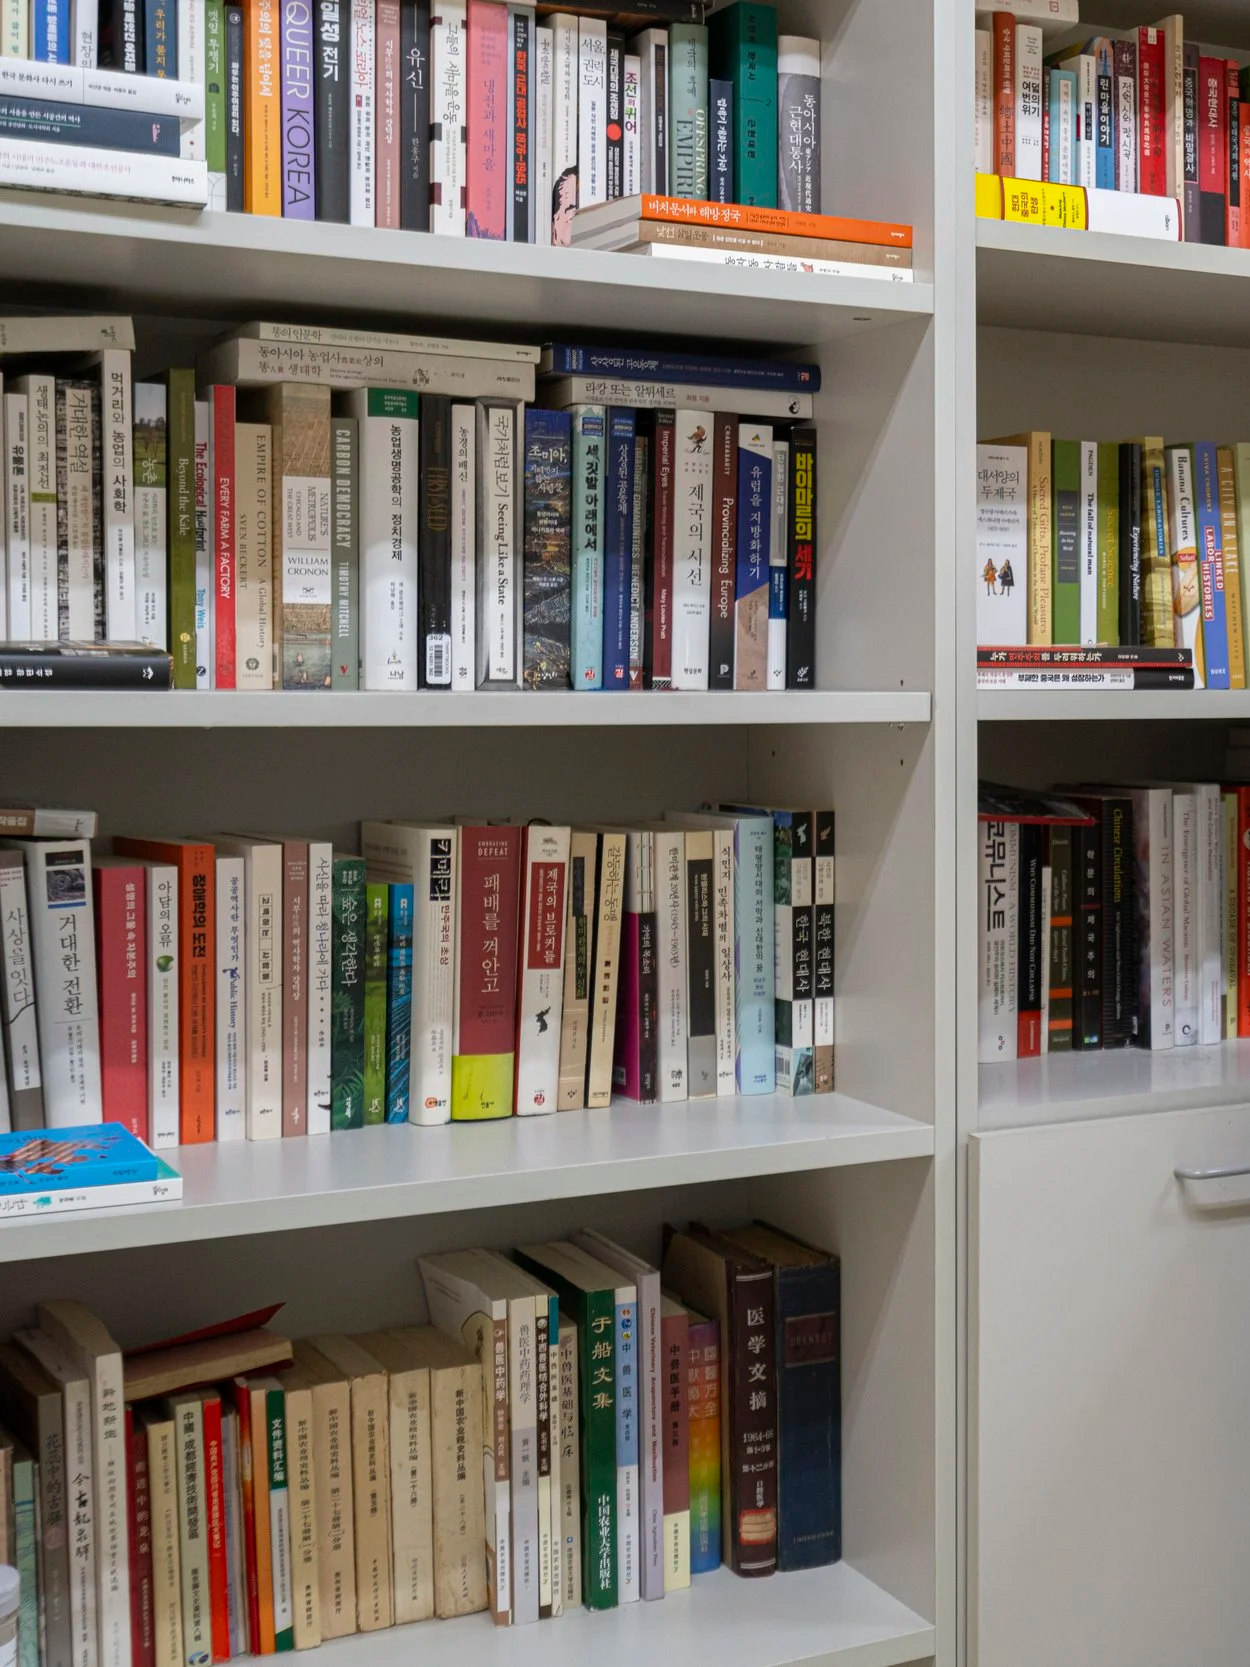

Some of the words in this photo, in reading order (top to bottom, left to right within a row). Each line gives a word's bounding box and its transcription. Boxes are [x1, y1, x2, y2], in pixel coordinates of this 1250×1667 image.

[208, 10, 218, 34] 깻잎
[447, 24, 459, 57] 그들의
[208, 39, 219, 74] 투쟁기
[286, 0, 309, 99] QUEER
[582, 38, 606, 56] 서울,
[583, 59, 604, 74] 권력
[406, 48, 426, 89] 유신
[583, 75, 604, 90] 도시
[1100, 78, 1109, 88] 린
[443, 61, 461, 124] 새마을운동
[483, 79, 496, 122] 냉전과
[625, 72, 637, 106] 조선의
[1100, 90, 1110, 114] 마을
[625, 107, 637, 134] 퀴어
[789, 106, 803, 174] 근현대통사
[803, 94, 816, 149] 동아시아
[1100, 115, 1110, 146] 이야기
[287, 108, 310, 205] KOREA
[483, 129, 496, 171] 새마을
[111, 372, 124, 424] 먹거리와
[585, 382, 608, 395] 라캉
[610, 384, 632, 397] 또는
[635, 387, 676, 400] 알튀세르
[113, 430, 125, 469] 농업의
[257, 435, 265, 483] EMPIRE
[336, 429, 350, 475] CARBON
[494, 415, 510, 468] 국가처럼
[618, 444, 628, 477] 상상된
[661, 431, 670, 465] Imperial
[391, 424, 402, 508] 농업생명공학의
[495, 469, 510, 499] 보기
[586, 462, 598, 486] 깃발
[661, 467, 670, 488] Eyes
[978, 470, 1019, 485] 대서양의
[1177, 456, 1188, 493] Banana
[113, 475, 126, 514] 사회학
[220, 477, 230, 503] EVERY
[256, 489, 265, 503] OF
[618, 482, 628, 515] 공동체
[751, 466, 762, 507] 유럽을
[981, 487, 993, 499] 두
[994, 486, 1016, 500] 제국
[1039, 476, 1048, 508] Sacred
[220, 505, 230, 538] FARM
[336, 480, 351, 549] DEMOCRACY
[494, 503, 508, 541] Seeing
[585, 493, 598, 551] 아래에서
[688, 483, 704, 541] 제국의
[1040, 509, 1048, 540] Gifts,
[1178, 496, 1191, 542] Cultures
[221, 541, 230, 550] A
[256, 511, 266, 568] COTTON
[391, 514, 402, 562] 정치경제
[497, 543, 508, 566] Like
[719, 498, 734, 574] Provincializing
[749, 511, 762, 580] 지방화하기
[1087, 536, 1095, 561] natural
[1205, 528, 1215, 562] LABOR
[220, 552, 230, 599] FACTORY
[240, 543, 248, 590] BECKERT
[287, 557, 329, 566] WILLIAM
[287, 567, 329, 577] CRONON
[339, 562, 349, 597] TIMOTHY
[687, 548, 702, 587] 시선
[1040, 541, 1049, 585] Profane
[1215, 551, 1223, 590] LINKED
[497, 578, 508, 606] State
[631, 564, 640, 603] BENEDICT
[720, 580, 733, 618] Europe
[1203, 563, 1213, 619] HISTORIES
[339, 600, 349, 638] MITCHELL
[1040, 588, 1050, 634] Pleasures
[630, 608, 639, 660] ANDERSON
[1113, 807, 1123, 845] Chinese
[478, 848, 508, 857] DEFEAT
[720, 847, 732, 881] 식민지
[1160, 846, 1169, 865] IN
[545, 868, 558, 909] 제국의
[985, 822, 1006, 932] 코뮤니스트
[1087, 850, 1095, 897] 학문의
[1113, 846, 1124, 904] Circulations
[158, 880, 172, 922] 아담의
[192, 874, 206, 928] 장애학의
[260, 896, 272, 937] 고백하는
[341, 895, 358, 926] 숲은
[483, 873, 501, 931] 패배를
[718, 888, 729, 943] 민족차별의
[1160, 873, 1171, 930] ASIAN
[7, 907, 25, 966] 사상을
[59, 914, 82, 973] 거대한
[159, 923, 173, 948] 오류
[192, 932, 206, 958] 도전
[543, 912, 558, 964] 브로커들
[795, 914, 809, 942] 한국
[818, 912, 832, 942] 북한
[260, 950, 272, 983] 사람들
[341, 930, 358, 987] 생각한다
[481, 936, 501, 993] 껴안고
[720, 947, 732, 982] 일상사
[1087, 914, 1096, 980] 제국주의
[10, 970, 31, 1005] 잇다
[795, 949, 810, 993] 현대사
[817, 949, 832, 992] 현대사
[1161, 939, 1172, 1008] WATERS
[63, 976, 84, 1016] 전환
[519, 1324, 532, 1405] 兽医中药药理学
[538, 1332, 549, 1422] 中西兽医结合外科学
[591, 1316, 614, 1410] 于船文集
[747, 1306, 768, 1411] 医学文摘
[598, 1493, 612, 1591] 中国农业大学出版社
